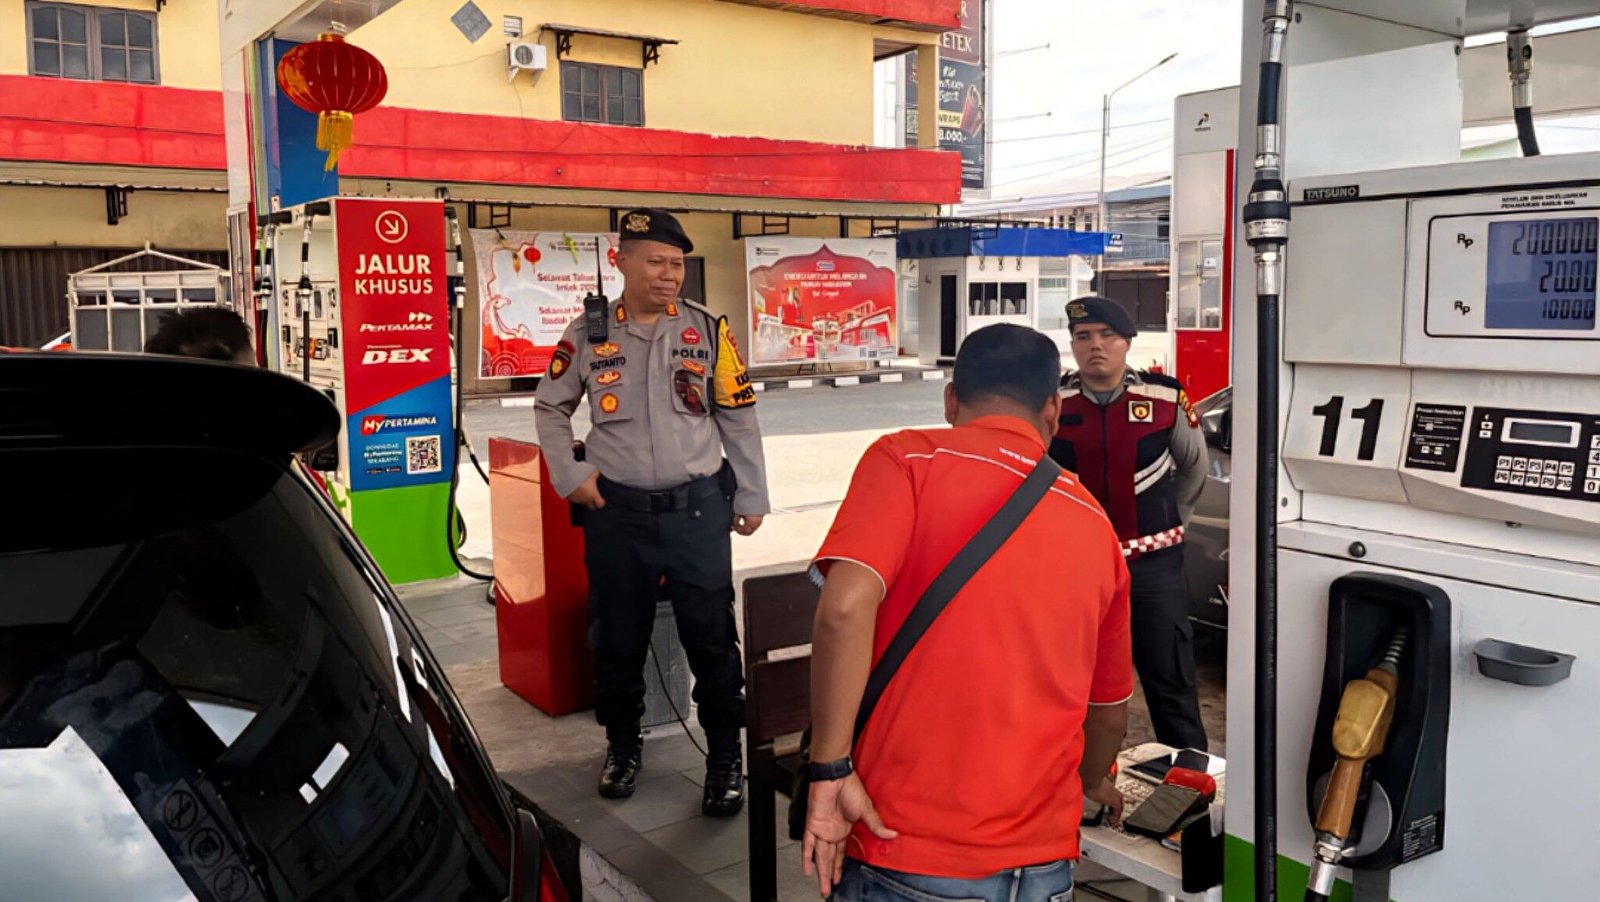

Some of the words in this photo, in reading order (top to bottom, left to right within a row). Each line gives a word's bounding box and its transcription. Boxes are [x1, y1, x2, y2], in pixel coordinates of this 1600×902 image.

[1306, 187, 1357, 200] TATSUNO
[1457, 233, 1473, 248] Rp
[355, 254, 431, 274] JALUR
[355, 279, 433, 294] KHUSUS
[1454, 300, 1471, 315] Rp
[1542, 298, 1595, 320] 10000
[361, 348, 434, 365] DEX
[1312, 394, 1385, 461] 11
[1514, 460, 1526, 468] P2
[1591, 468, 1597, 476] 1
[1587, 481, 1596, 491] 0
